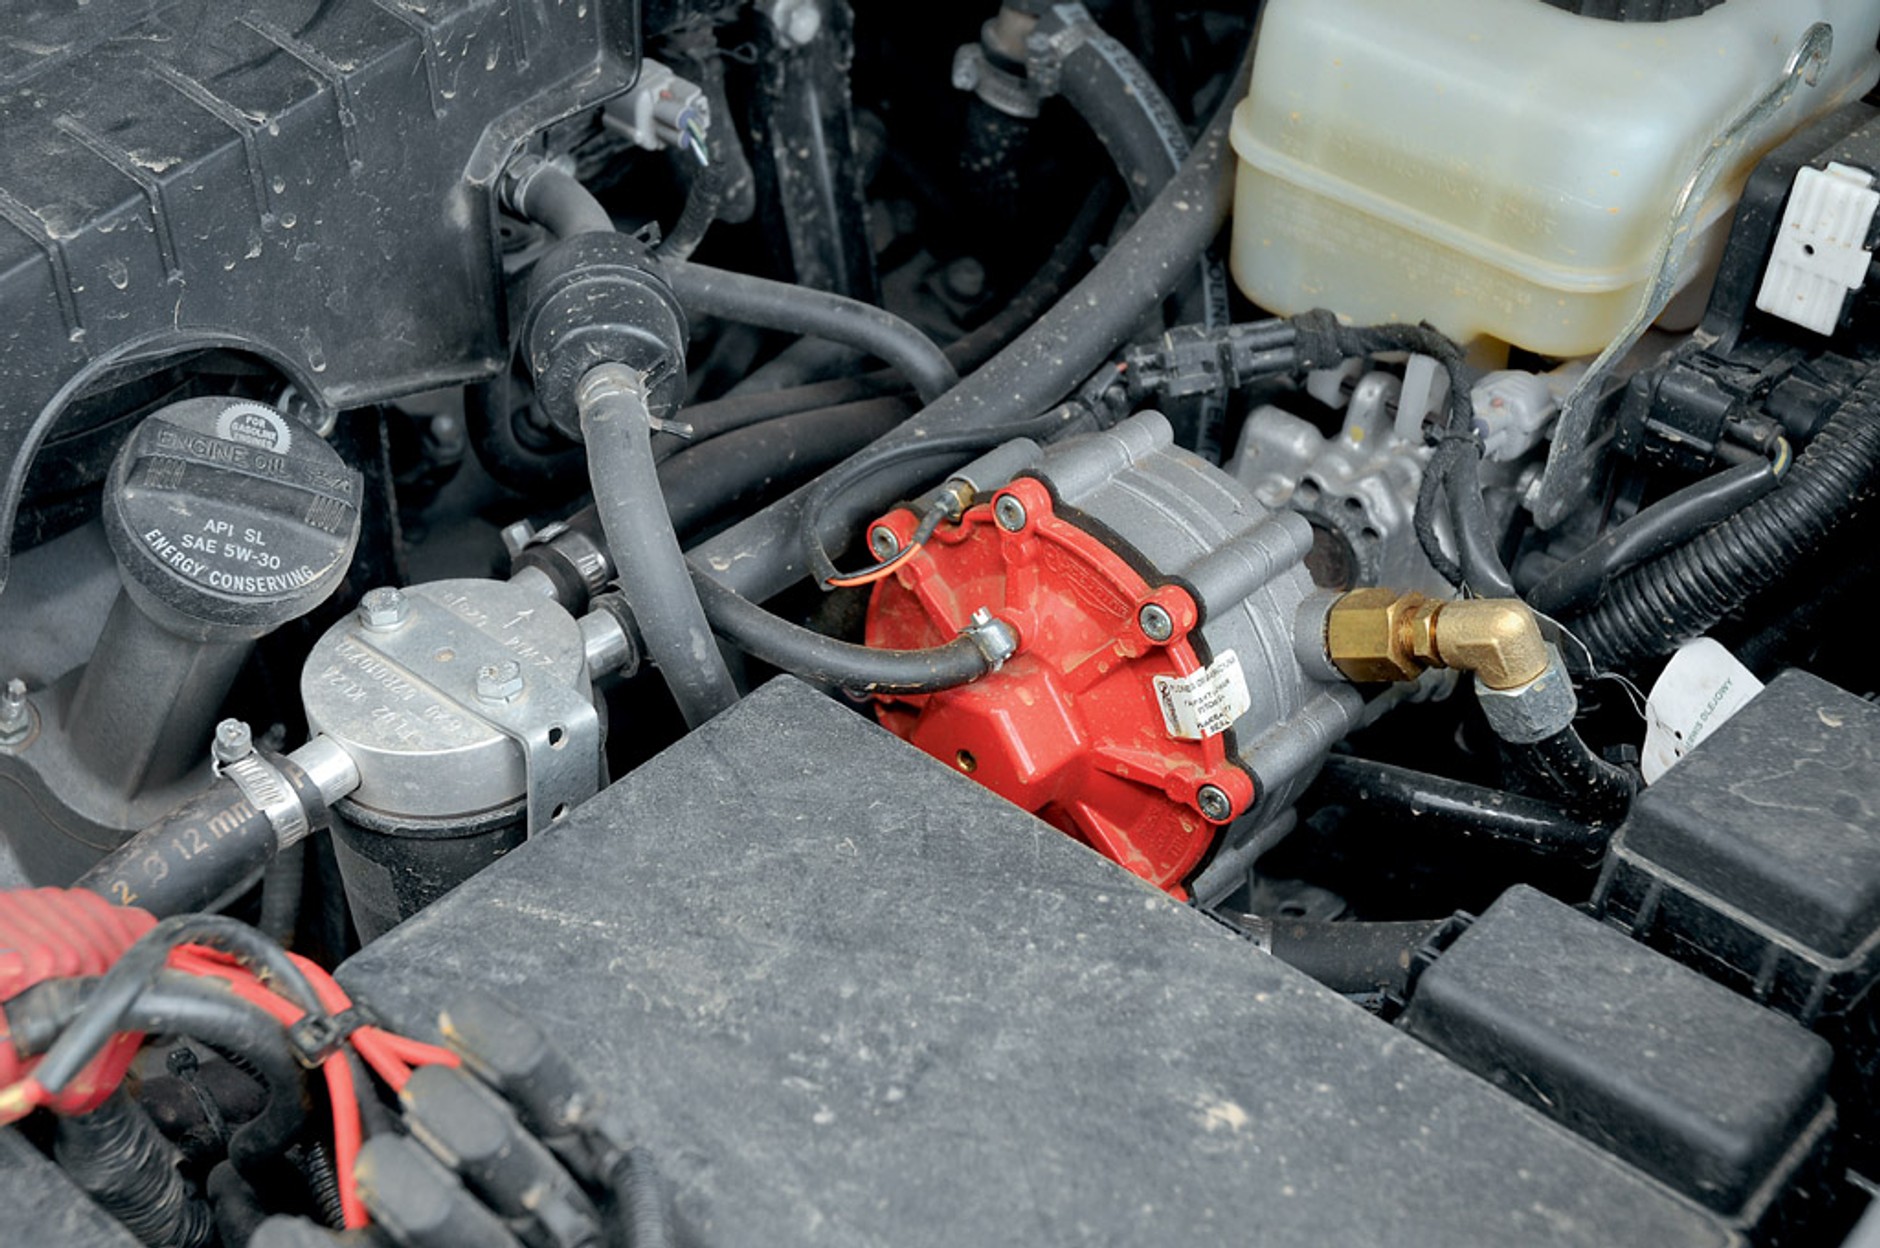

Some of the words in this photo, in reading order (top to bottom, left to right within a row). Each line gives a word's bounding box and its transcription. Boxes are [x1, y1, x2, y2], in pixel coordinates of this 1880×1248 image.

[245, 414, 266, 430] FOR
[157, 430, 250, 468] ENGINE
[254, 454, 293, 477] OIL
[181, 534, 217, 554] SAE
[223, 543, 281, 570] 5W-30
[203, 519, 234, 537] API
[244, 528, 266, 546] SL
[144, 528, 206, 576] ENERGY
[208, 564, 315, 593] CONSERVING
[171, 828, 212, 861] 12
[206, 799, 256, 840] mm
